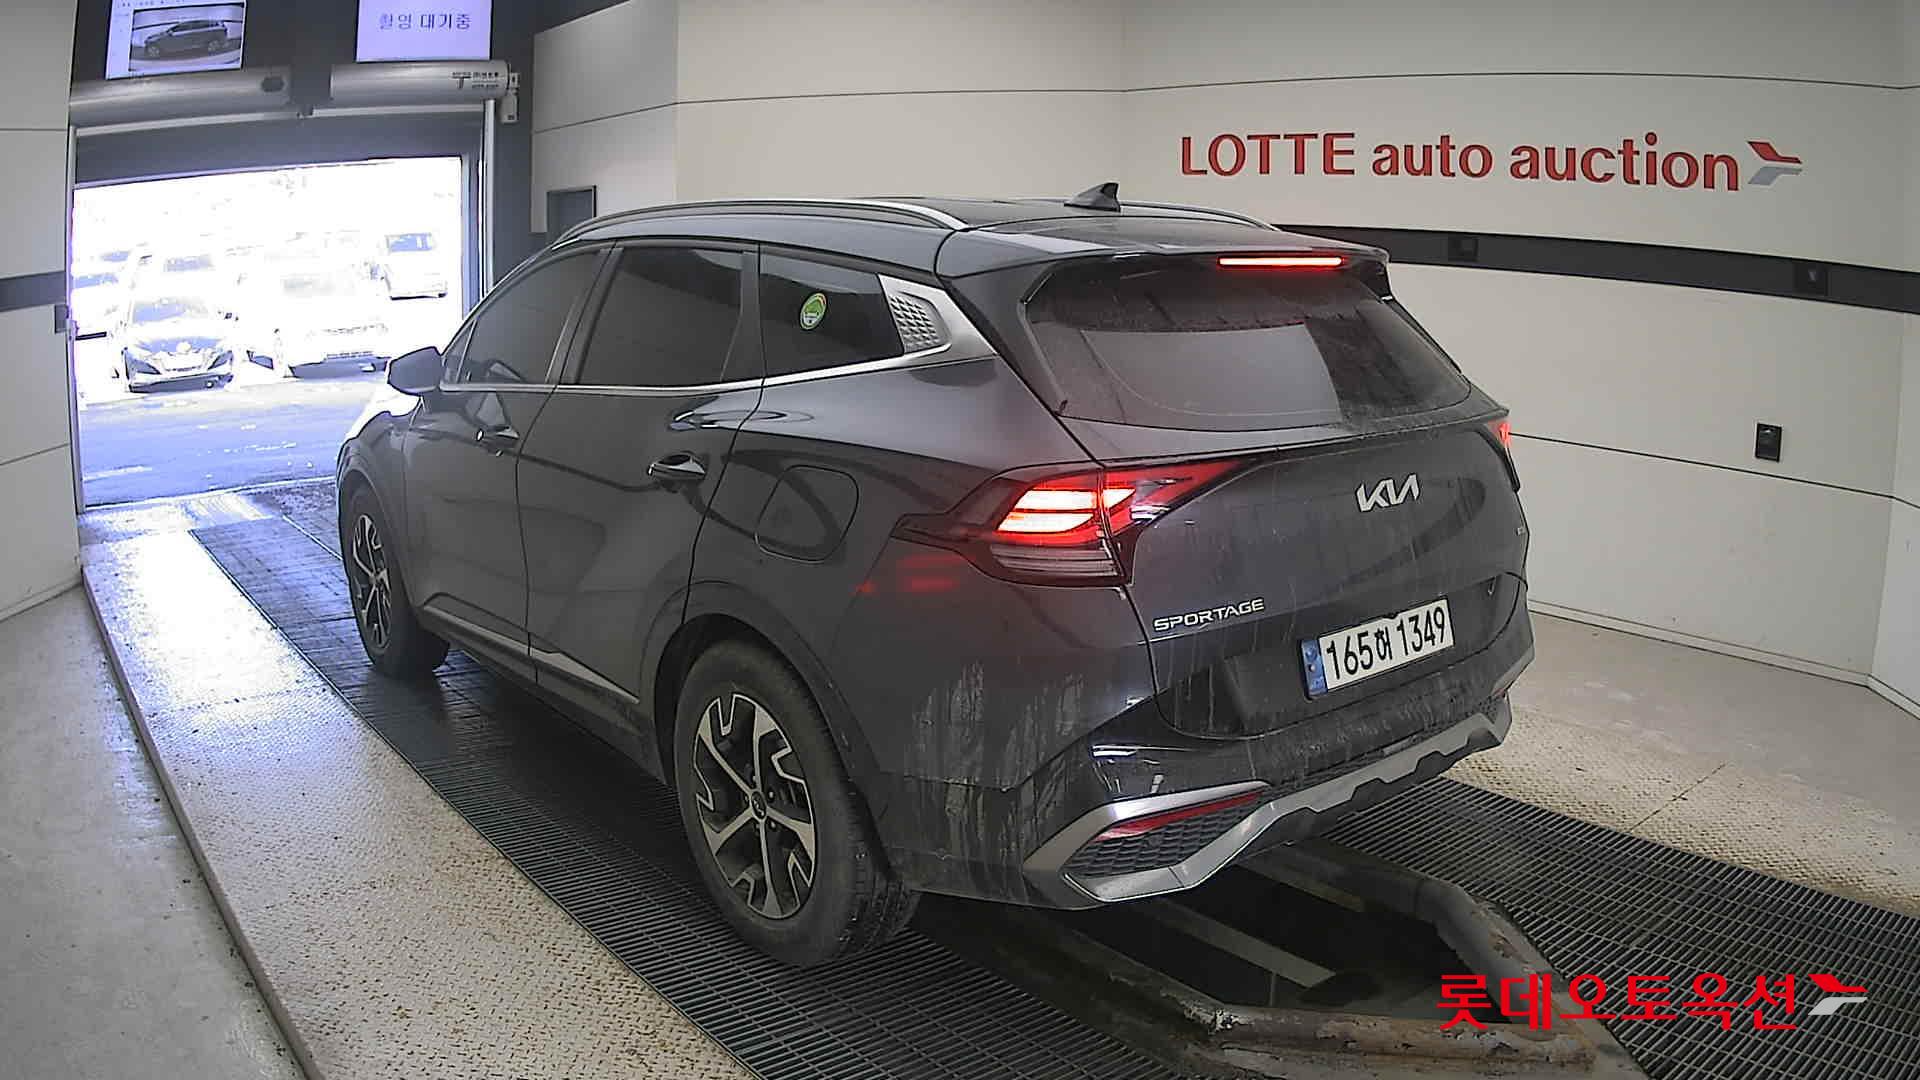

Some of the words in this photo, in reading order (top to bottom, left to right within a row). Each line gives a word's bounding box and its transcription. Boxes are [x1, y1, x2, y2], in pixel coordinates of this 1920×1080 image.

[420, 13, 472, 30] 대기중
[1181, 133, 1355, 177] LOTTE
[1373, 136, 1495, 178] auto
[1510, 132, 1740, 192] auction
[1357, 474, 1420, 511] KIA
[1153, 598, 1265, 631] SPORTAGE
[1326, 625, 1393, 680] 165허
[1396, 606, 1446, 656] 1349
